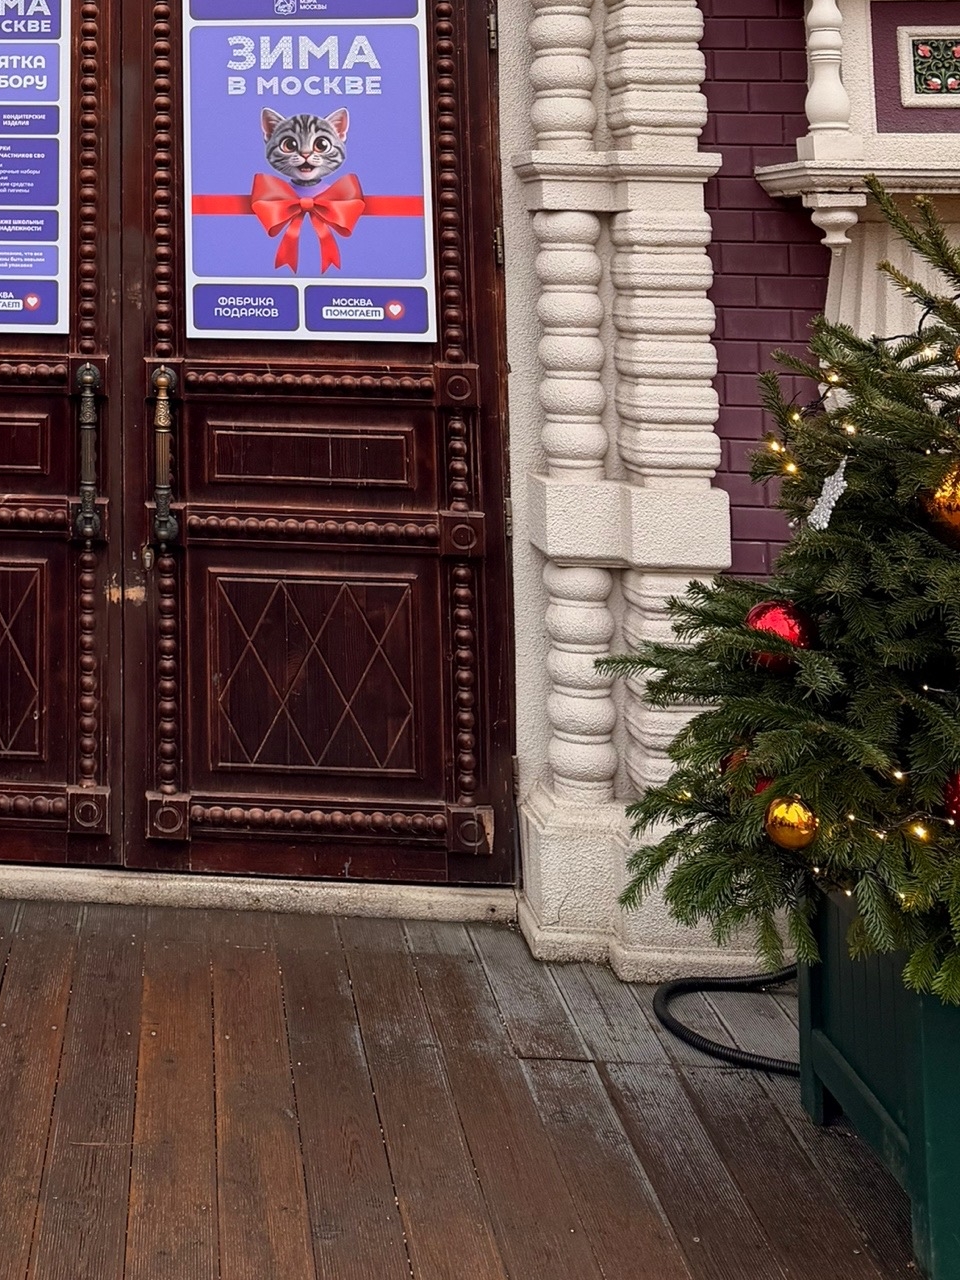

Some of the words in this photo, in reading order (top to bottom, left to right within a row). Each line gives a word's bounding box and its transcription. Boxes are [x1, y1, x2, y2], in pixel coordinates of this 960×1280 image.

[227, 36, 382, 70] ЗИМА
[228, 76, 247, 95] В
[257, 76, 382, 95] МОСКВЕ
[218, 297, 274, 306] ФАБРИКА
[332, 298, 373, 306] МОСКВА
[214, 307, 279, 318] ПОДАРКОВ
